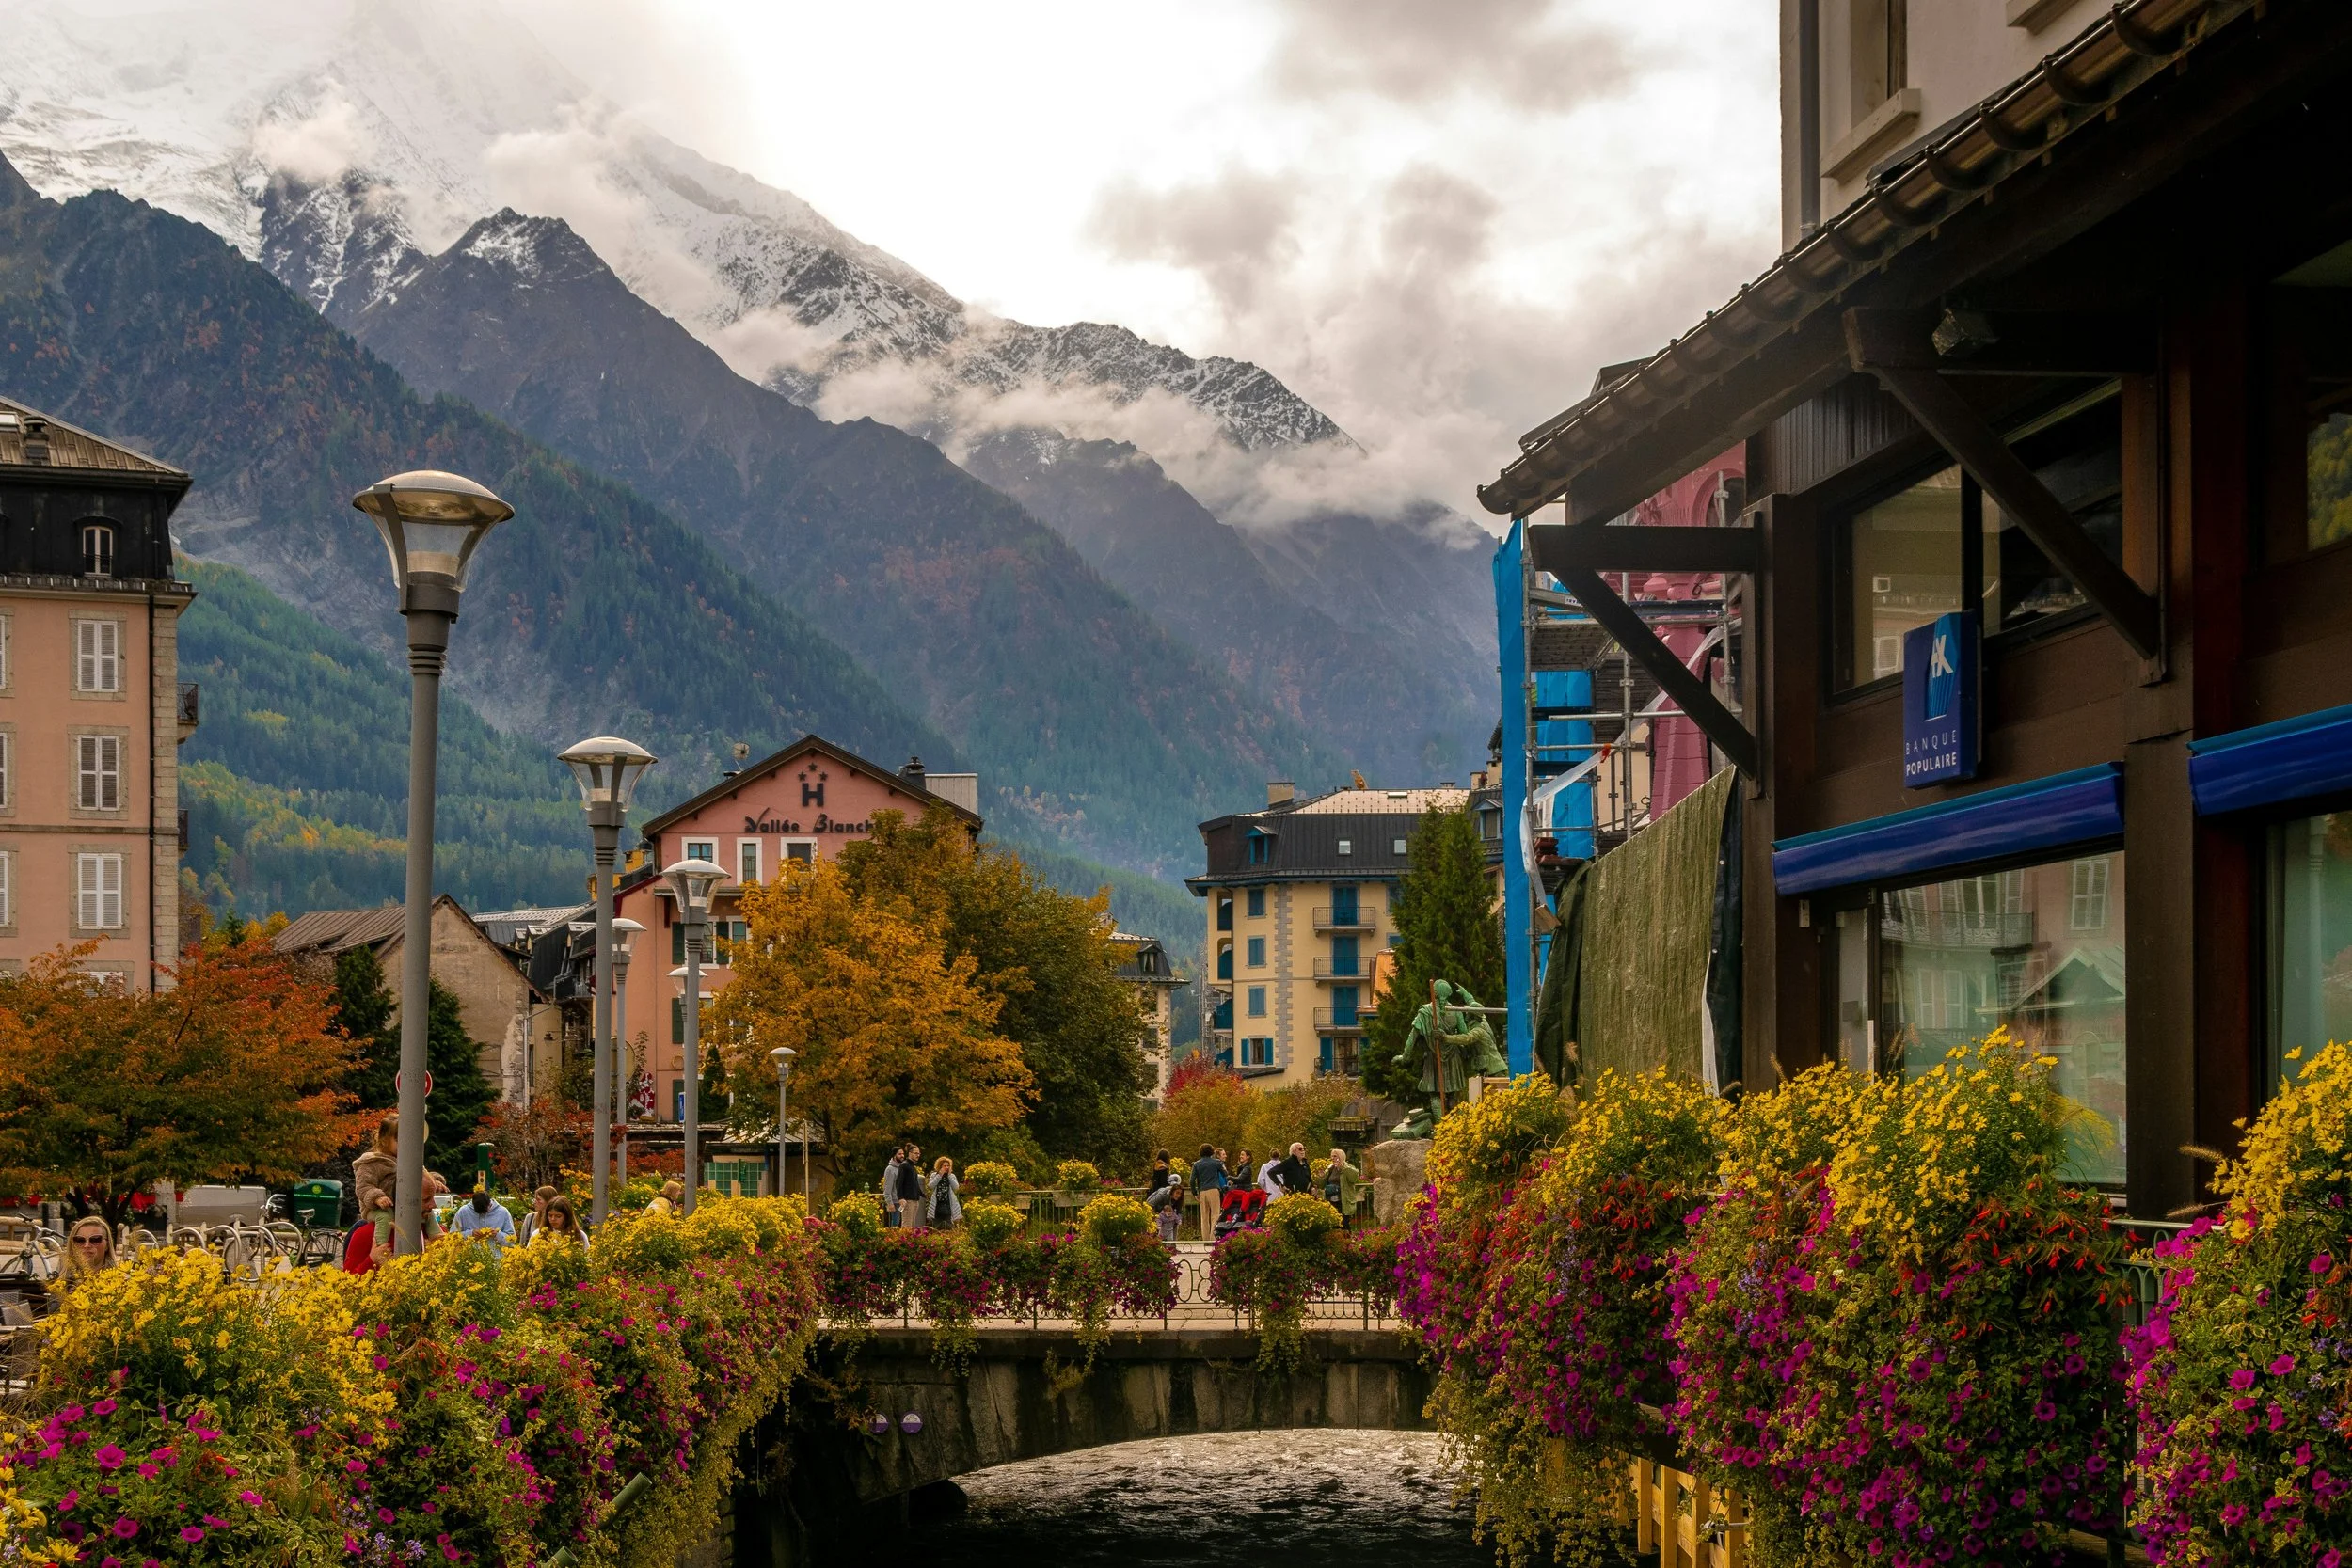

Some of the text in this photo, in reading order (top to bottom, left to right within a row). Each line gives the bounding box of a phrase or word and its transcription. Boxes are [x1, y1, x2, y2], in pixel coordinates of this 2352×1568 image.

[1905, 729, 1957, 755] BANQUE
[1906, 752, 1957, 776] POPULAIRE
[802, 783, 824, 807] H
[744, 807, 876, 833] Vallée Blanch
